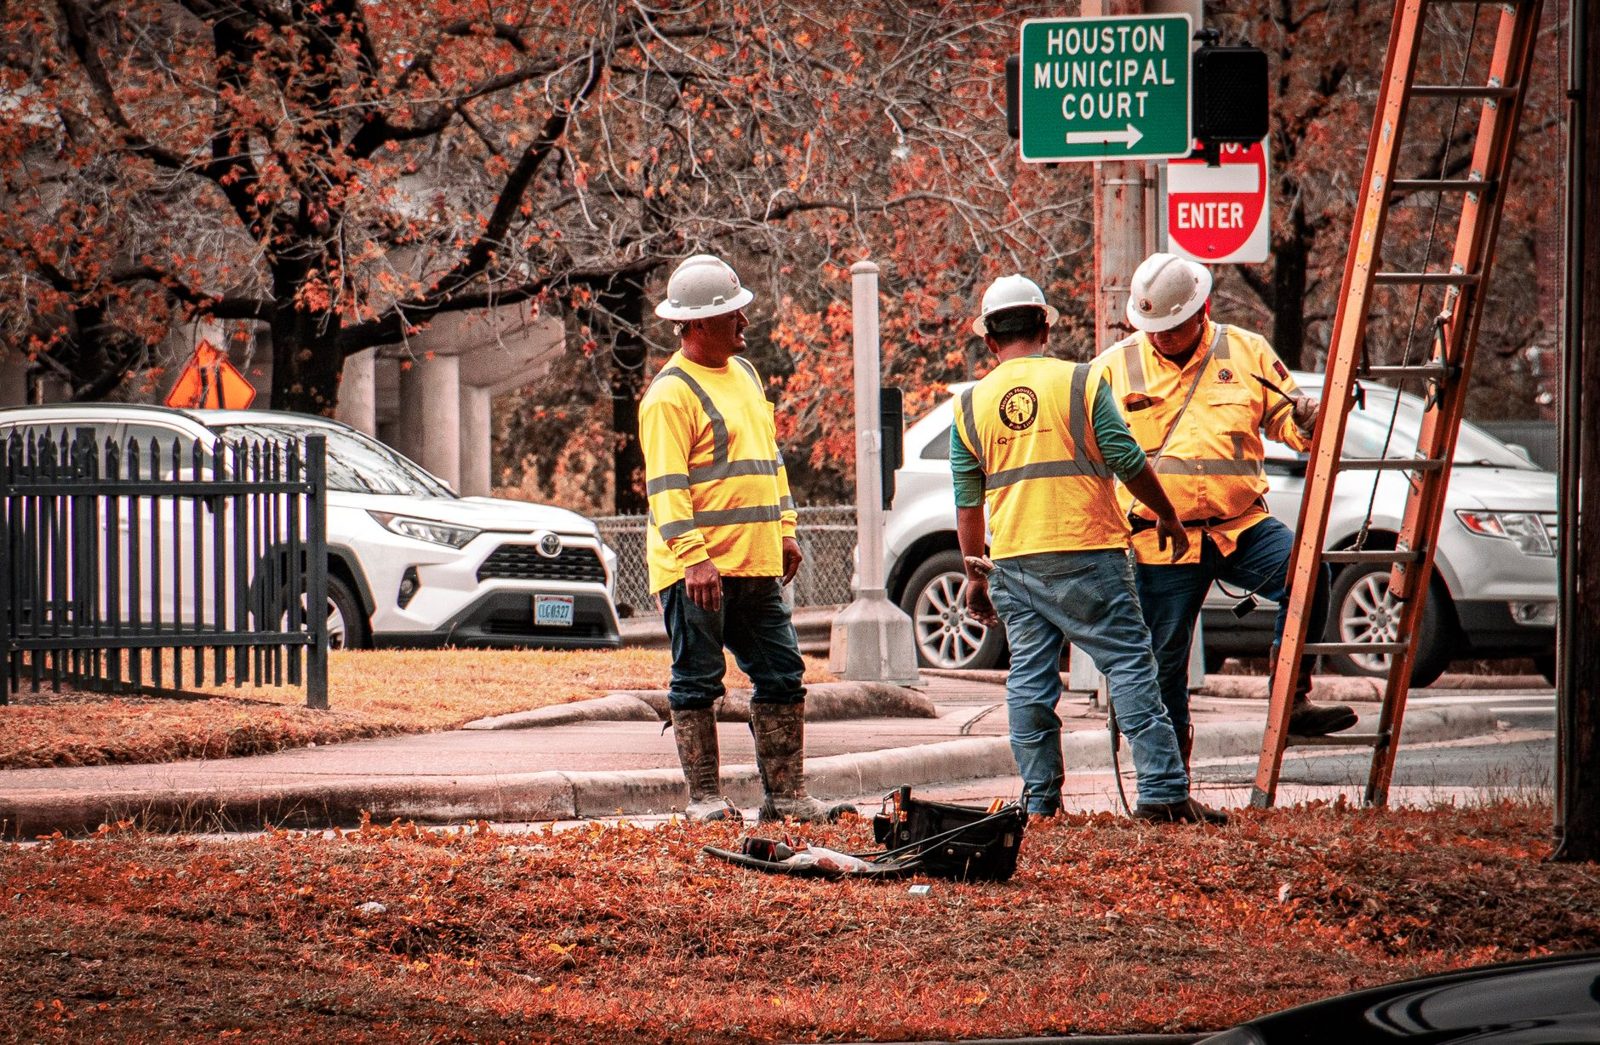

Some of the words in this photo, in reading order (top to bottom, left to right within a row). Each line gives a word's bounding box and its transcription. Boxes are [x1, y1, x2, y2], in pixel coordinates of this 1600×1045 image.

[1047, 25, 1166, 56] HOUSTON
[1034, 59, 1175, 89] MUNICIPAL
[1061, 91, 1149, 120] COURT
[1177, 202, 1244, 229] ENTER
